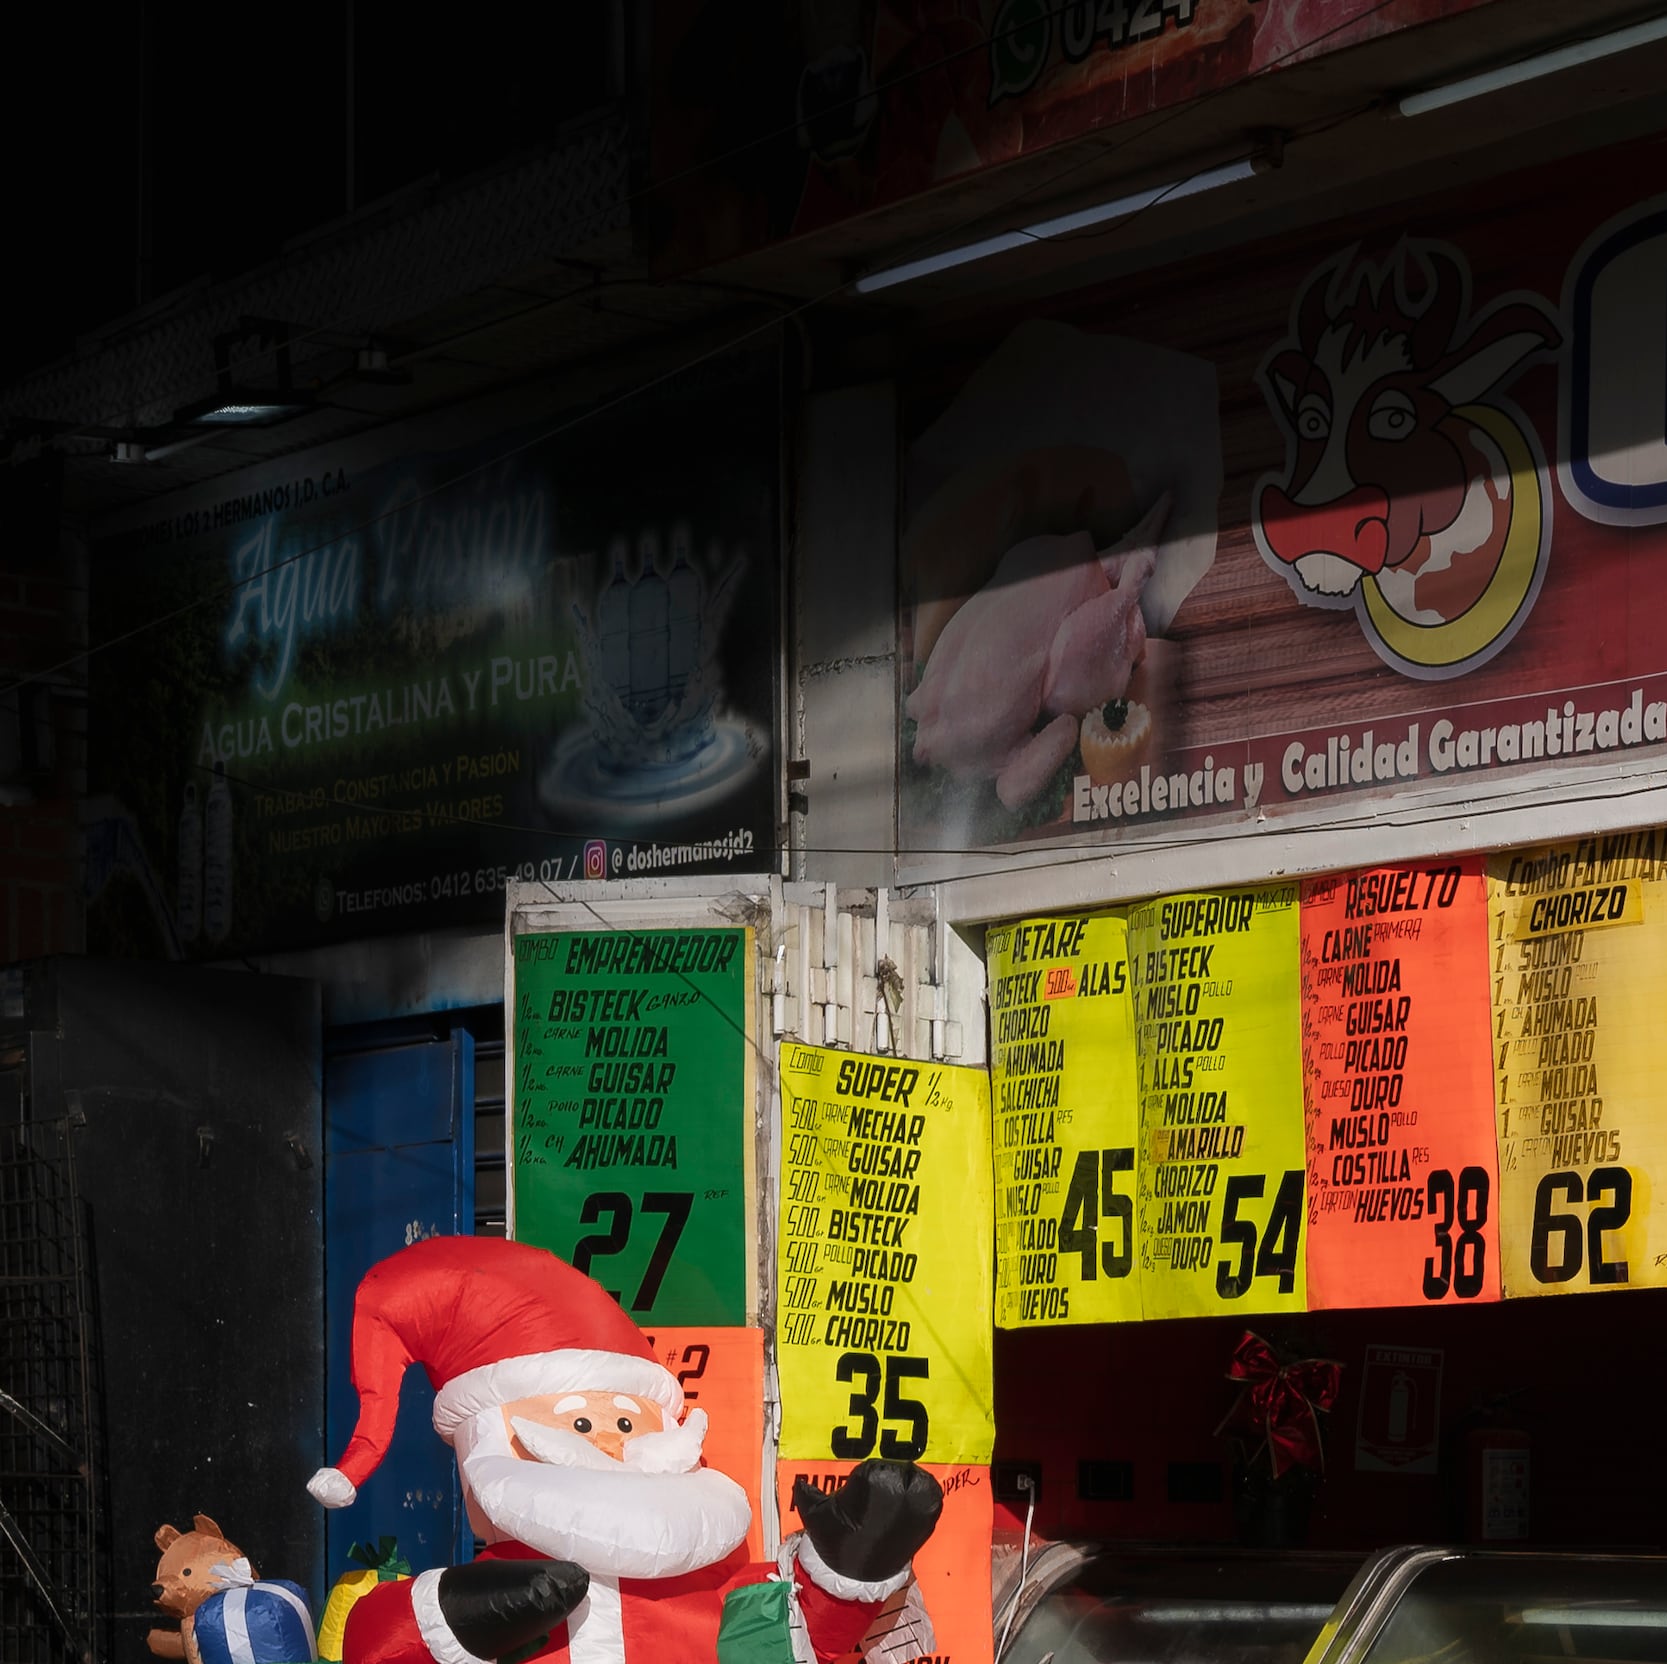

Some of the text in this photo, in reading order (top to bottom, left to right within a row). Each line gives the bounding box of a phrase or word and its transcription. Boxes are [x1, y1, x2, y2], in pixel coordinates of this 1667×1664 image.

[213, 486, 290, 528] HERMANOS
[228, 515, 363, 699] Agua
[202, 650, 583, 763] AGUA CRISTALINA Y PURA
[1073, 755, 1234, 824] Excelencia
[1243, 762, 1264, 809] y
[1281, 723, 1420, 793] Calidad
[1428, 688, 1667, 772] Garantizada
[431, 872, 471, 901] 0412
[627, 831, 755, 871] doshermanosjd2
[1345, 865, 1462, 919] RESUELTO
[1530, 886, 1627, 932] CHORIZO
[1161, 894, 1254, 940] SUPERIOR
[565, 935, 738, 975] EMPRENDEDOR
[1078, 961, 1126, 998] ALAS
[548, 990, 643, 1023] BISTECK
[999, 1005, 1050, 1040] CHORIZO
[1521, 997, 1598, 1038] AHUMADA
[588, 1063, 676, 1095] GUISAR
[837, 1060, 918, 1107] SUPER
[847, 1105, 925, 1146] MECHAR
[1167, 1126, 1245, 1159] AMARILLO
[565, 1134, 677, 1170] AHUMADA
[1332, 1149, 1411, 1188] COSTILLA
[1058, 1147, 1135, 1281] 45
[1156, 1201, 1209, 1235] JAMON
[1354, 1188, 1424, 1224] HUEVOS
[1531, 1166, 1632, 1285] 62
[573, 1192, 694, 1311] 27
[1216, 1170, 1305, 1299] 54
[1423, 1166, 1490, 1300] 38
[826, 1281, 894, 1316] MUSLO
[830, 1352, 931, 1460] 35
